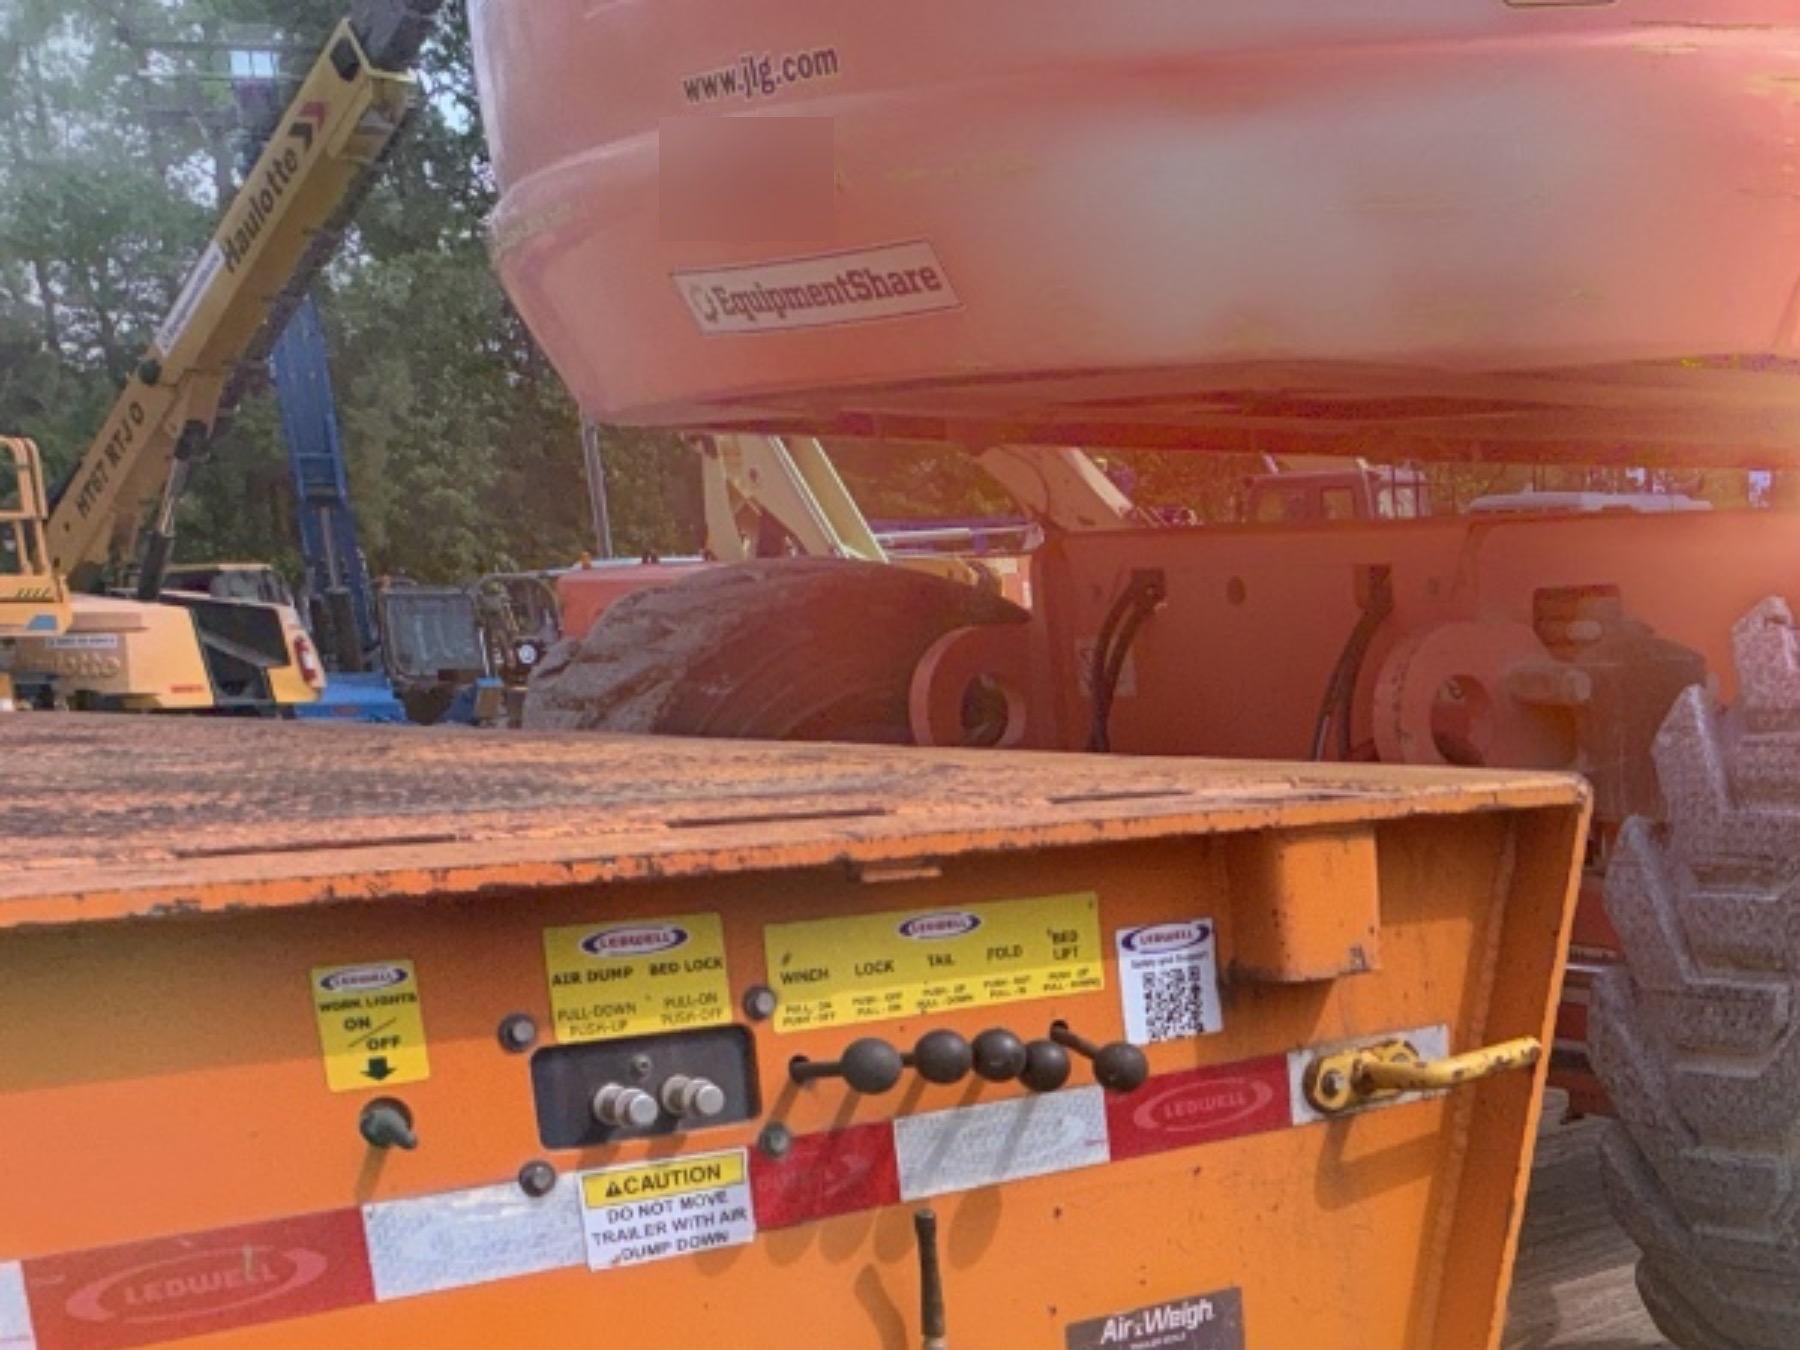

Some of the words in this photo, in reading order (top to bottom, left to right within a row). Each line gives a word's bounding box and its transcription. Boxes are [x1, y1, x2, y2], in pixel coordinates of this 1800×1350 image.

[683, 48, 838, 102] www.jlg.com
[222, 148, 299, 274] Haulotte
[715, 264, 944, 322] EquipmentShare
[986, 945, 1023, 961] FOLD
[552, 970, 582, 986] AIR
[586, 965, 634, 983] DUMP
[648, 962, 681, 977] BED
[684, 957, 723, 973] LOCK
[780, 968, 829, 985] WINCH
[854, 960, 895, 976] LOCK
[663, 992, 718, 1009] PULL-ON
[557, 1002, 637, 1021] PULL-DOWN
[344, 1016, 371, 1031] ON
[569, 1019, 629, 1037] PUSH-UP
[366, 1035, 400, 1051] OFF
[623, 1164, 722, 1195] CAUTION
[607, 1208, 634, 1225] DO
[638, 1200, 674, 1220] NOT
[680, 1190, 728, 1210] MOVE
[591, 1221, 667, 1246] TRAILER
[672, 1213, 715, 1232] WITH
[719, 1206, 748, 1224] AIR
[619, 1241, 674, 1262] DUMP
[677, 1231, 729, 1251] DOWN
